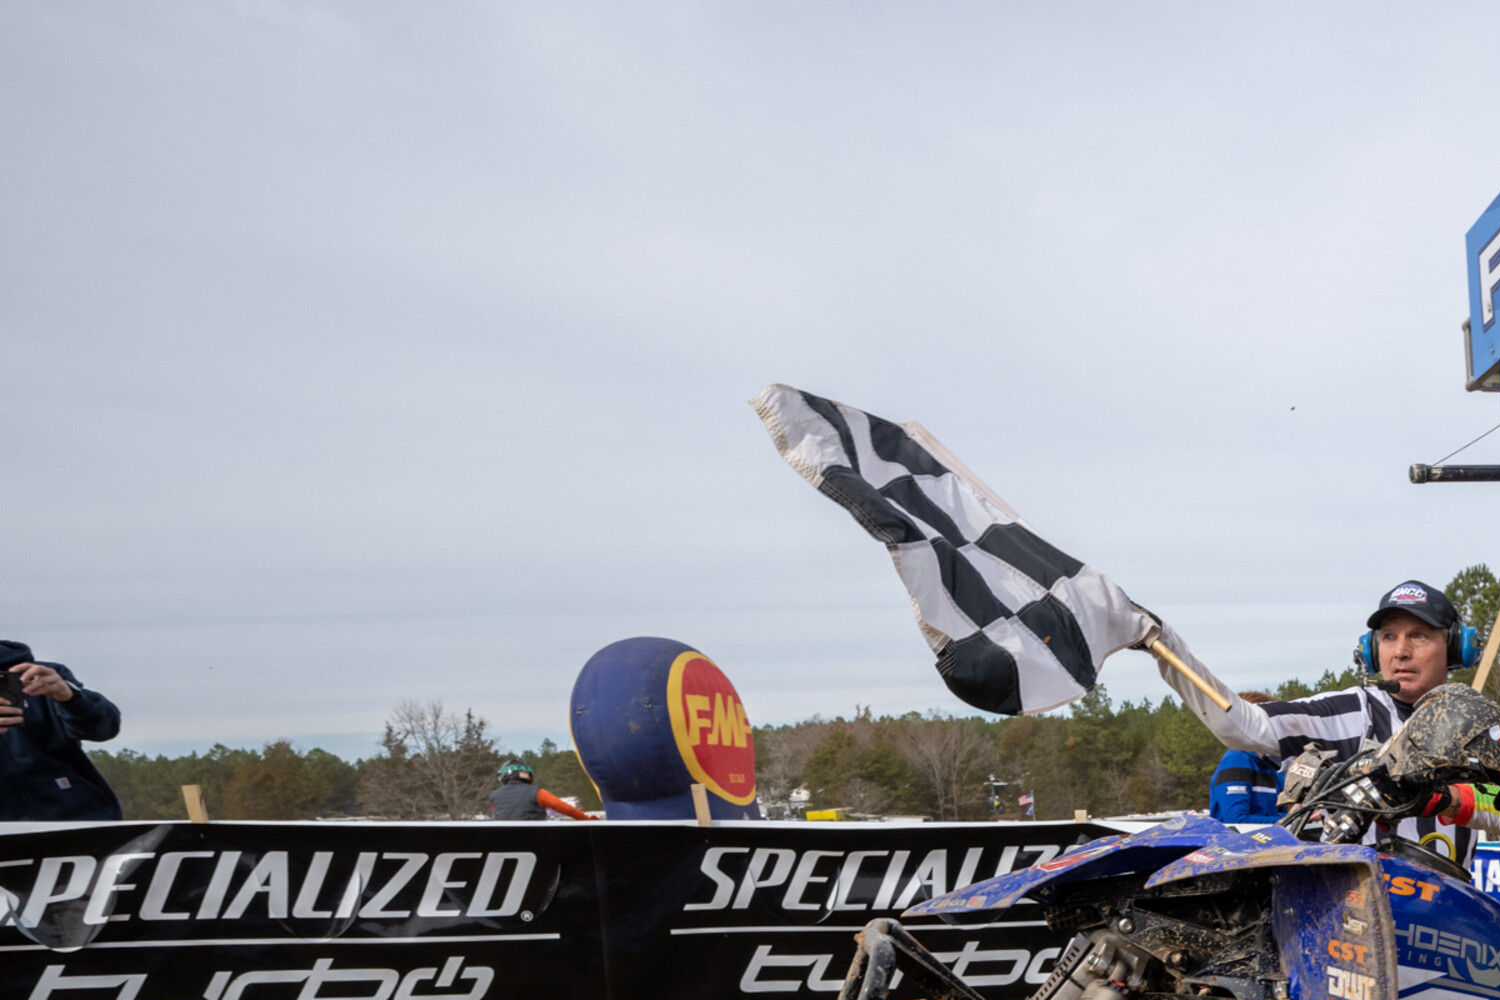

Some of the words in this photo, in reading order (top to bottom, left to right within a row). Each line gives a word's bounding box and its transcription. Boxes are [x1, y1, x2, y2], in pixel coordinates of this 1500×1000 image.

[685, 692, 752, 748] FMF
[683, 845, 1086, 912] SPECIALIZ
[1384, 873, 1440, 902] ST
[1327, 939, 1368, 964] CST
